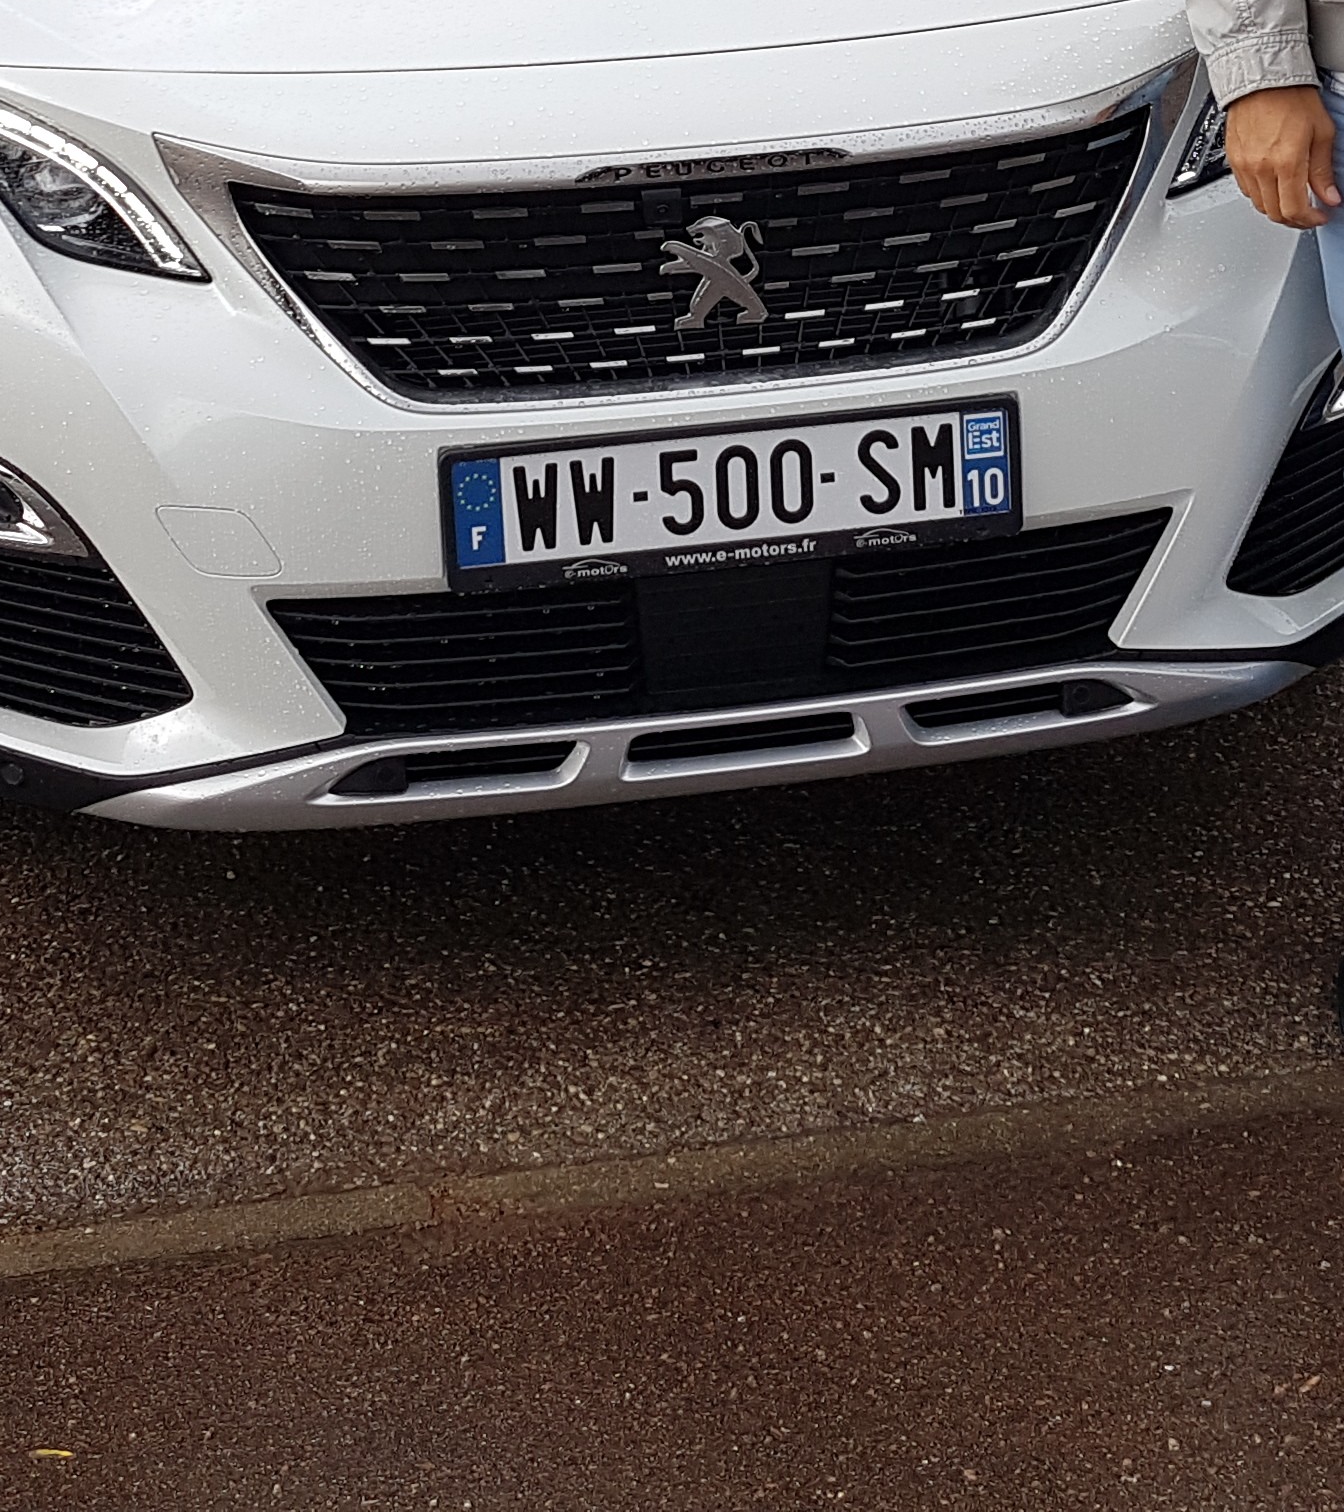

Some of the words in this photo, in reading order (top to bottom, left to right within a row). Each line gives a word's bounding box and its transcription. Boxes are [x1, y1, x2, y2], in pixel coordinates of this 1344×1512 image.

[613, 153, 813, 180] PEUGEOT
[968, 419, 1000, 431] Grand
[968, 431, 1000, 449] Est
[967, 467, 1004, 507] 10
[471, 526, 487, 550] F
[665, 539, 817, 567] www.e-motors.fr
